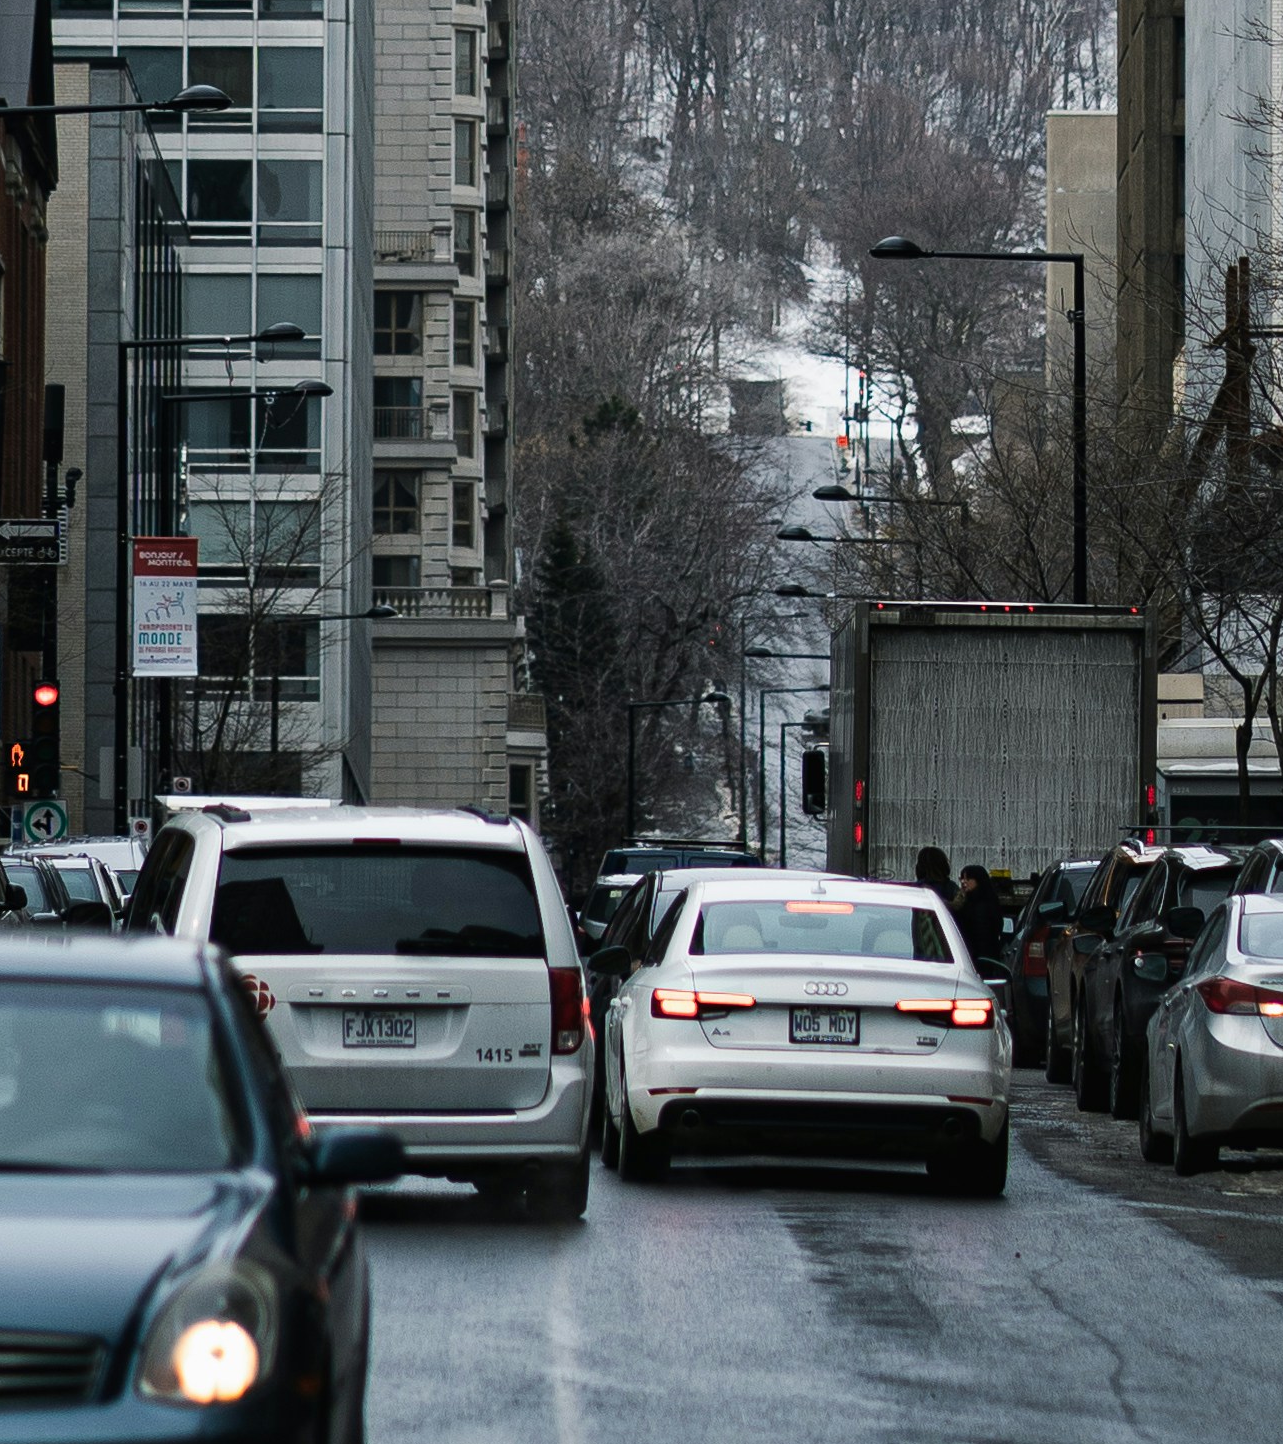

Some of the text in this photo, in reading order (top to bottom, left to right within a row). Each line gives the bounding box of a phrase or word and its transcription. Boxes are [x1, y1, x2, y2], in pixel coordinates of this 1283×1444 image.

[139, 632, 182, 645] MONDE
[346, 1019, 413, 1038] FJX1302
[476, 1049, 513, 1062] 1415
